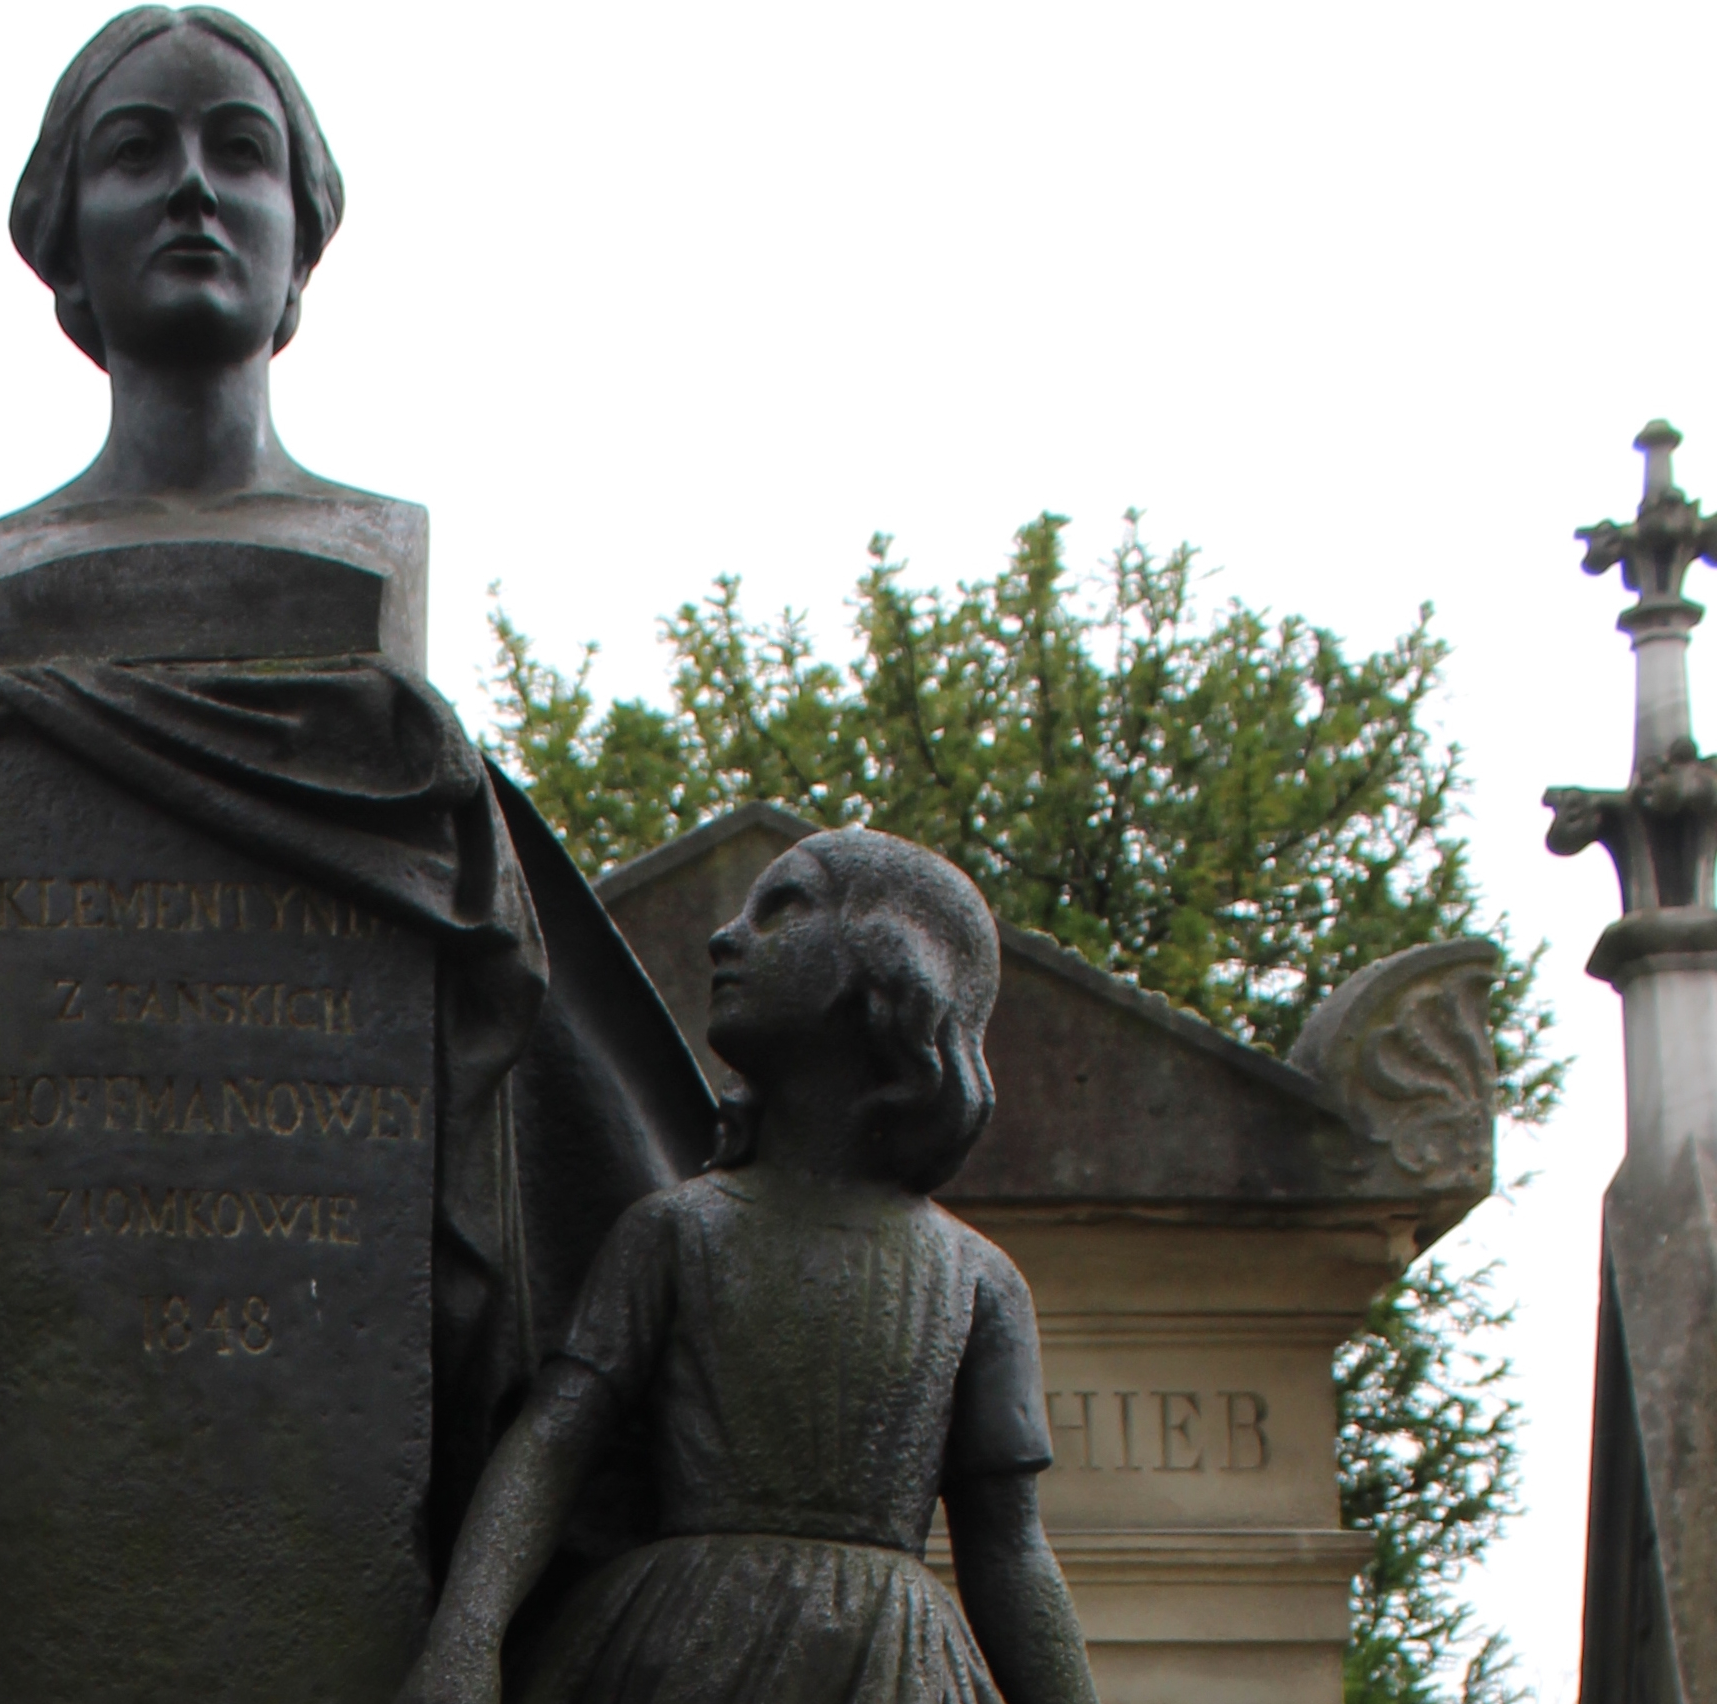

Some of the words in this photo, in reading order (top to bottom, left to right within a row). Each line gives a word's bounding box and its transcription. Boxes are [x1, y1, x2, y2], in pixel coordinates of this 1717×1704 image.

[54, 980, 82, 1022] Z
[46, 1187, 359, 1245] ZIOMKOWIE
[141, 1295, 274, 1356] 1848
[1045, 1390, 1271, 1473] HIEB
